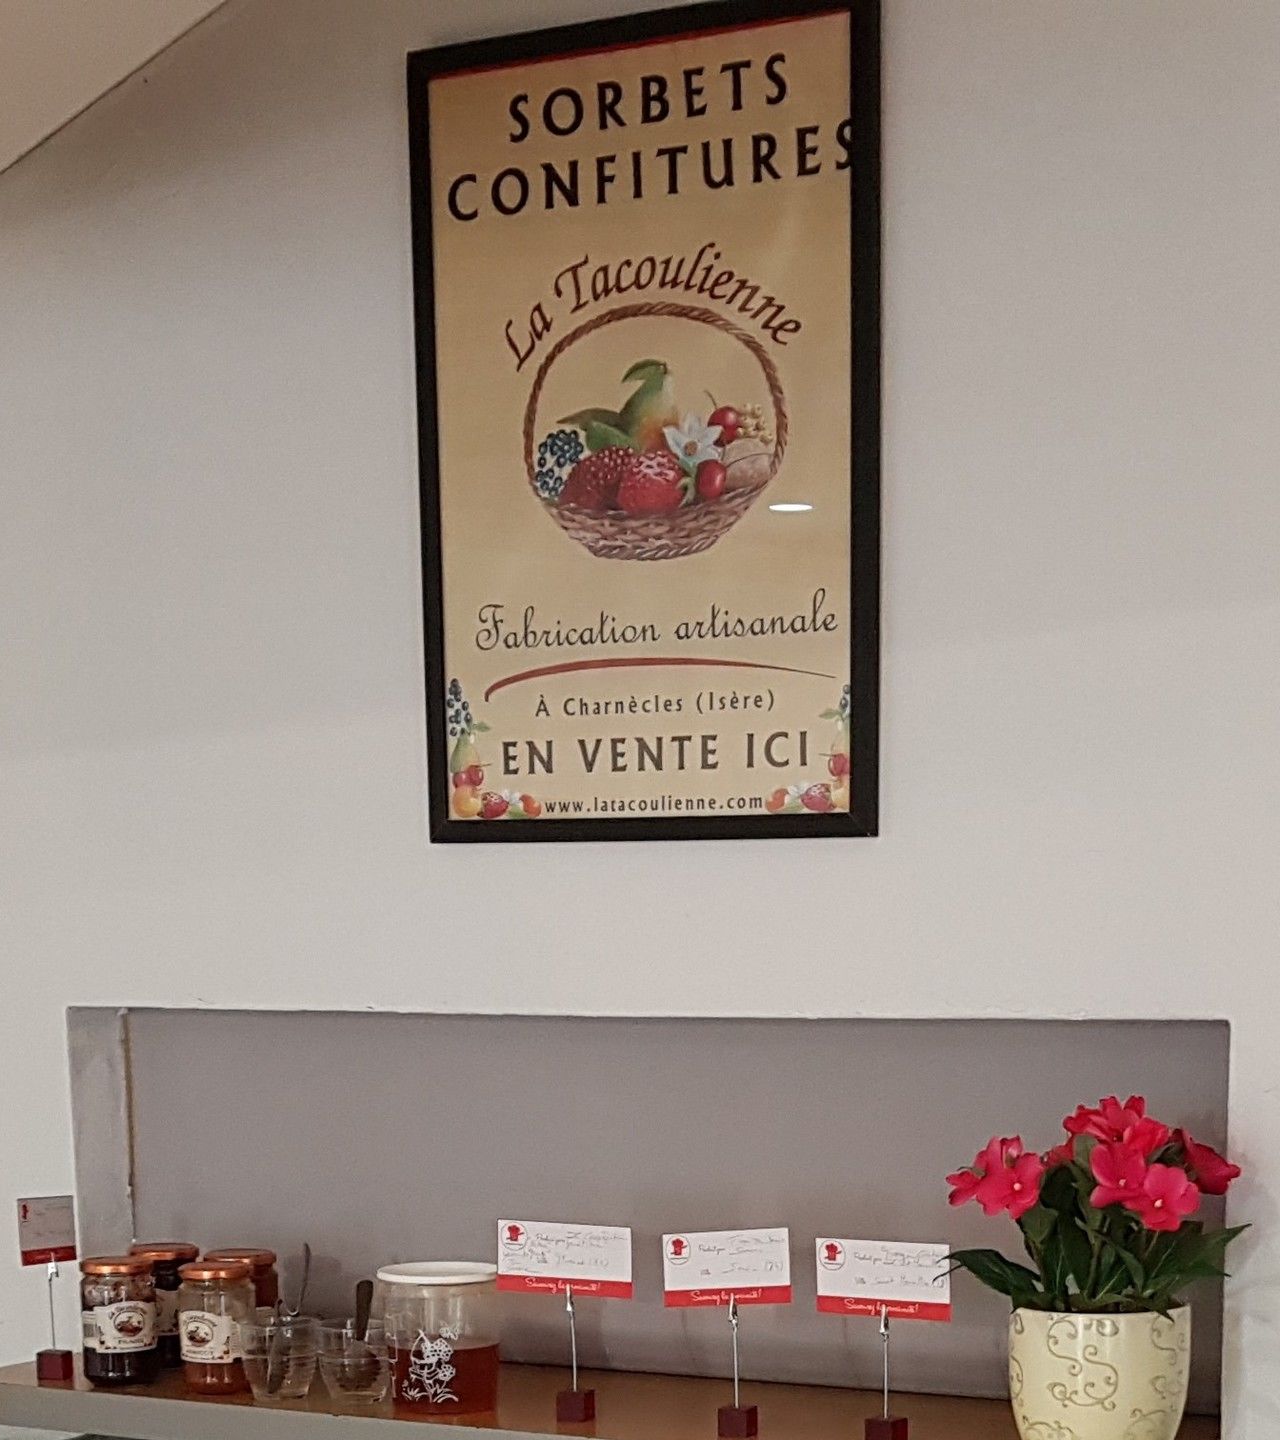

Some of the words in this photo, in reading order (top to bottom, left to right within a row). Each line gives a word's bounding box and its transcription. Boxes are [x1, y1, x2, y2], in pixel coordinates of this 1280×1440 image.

[508, 53, 788, 143] SORBETS
[447, 119, 851, 222] CONFITURES
[504, 302, 554, 373] La
[554, 242, 803, 346] Tacoulienne
[475, 603, 661, 652] Fabrication
[673, 587, 839, 642] artisanale
[534, 693, 551, 718] À
[563, 694, 683, 717] Charnècles
[695, 688, 776, 716] (Isère)
[501, 739, 554, 776] EN
[577, 733, 720, 775] VENTE
[745, 729, 809, 770] ICI
[544, 794, 764, 814] www.latacoulienne.com
